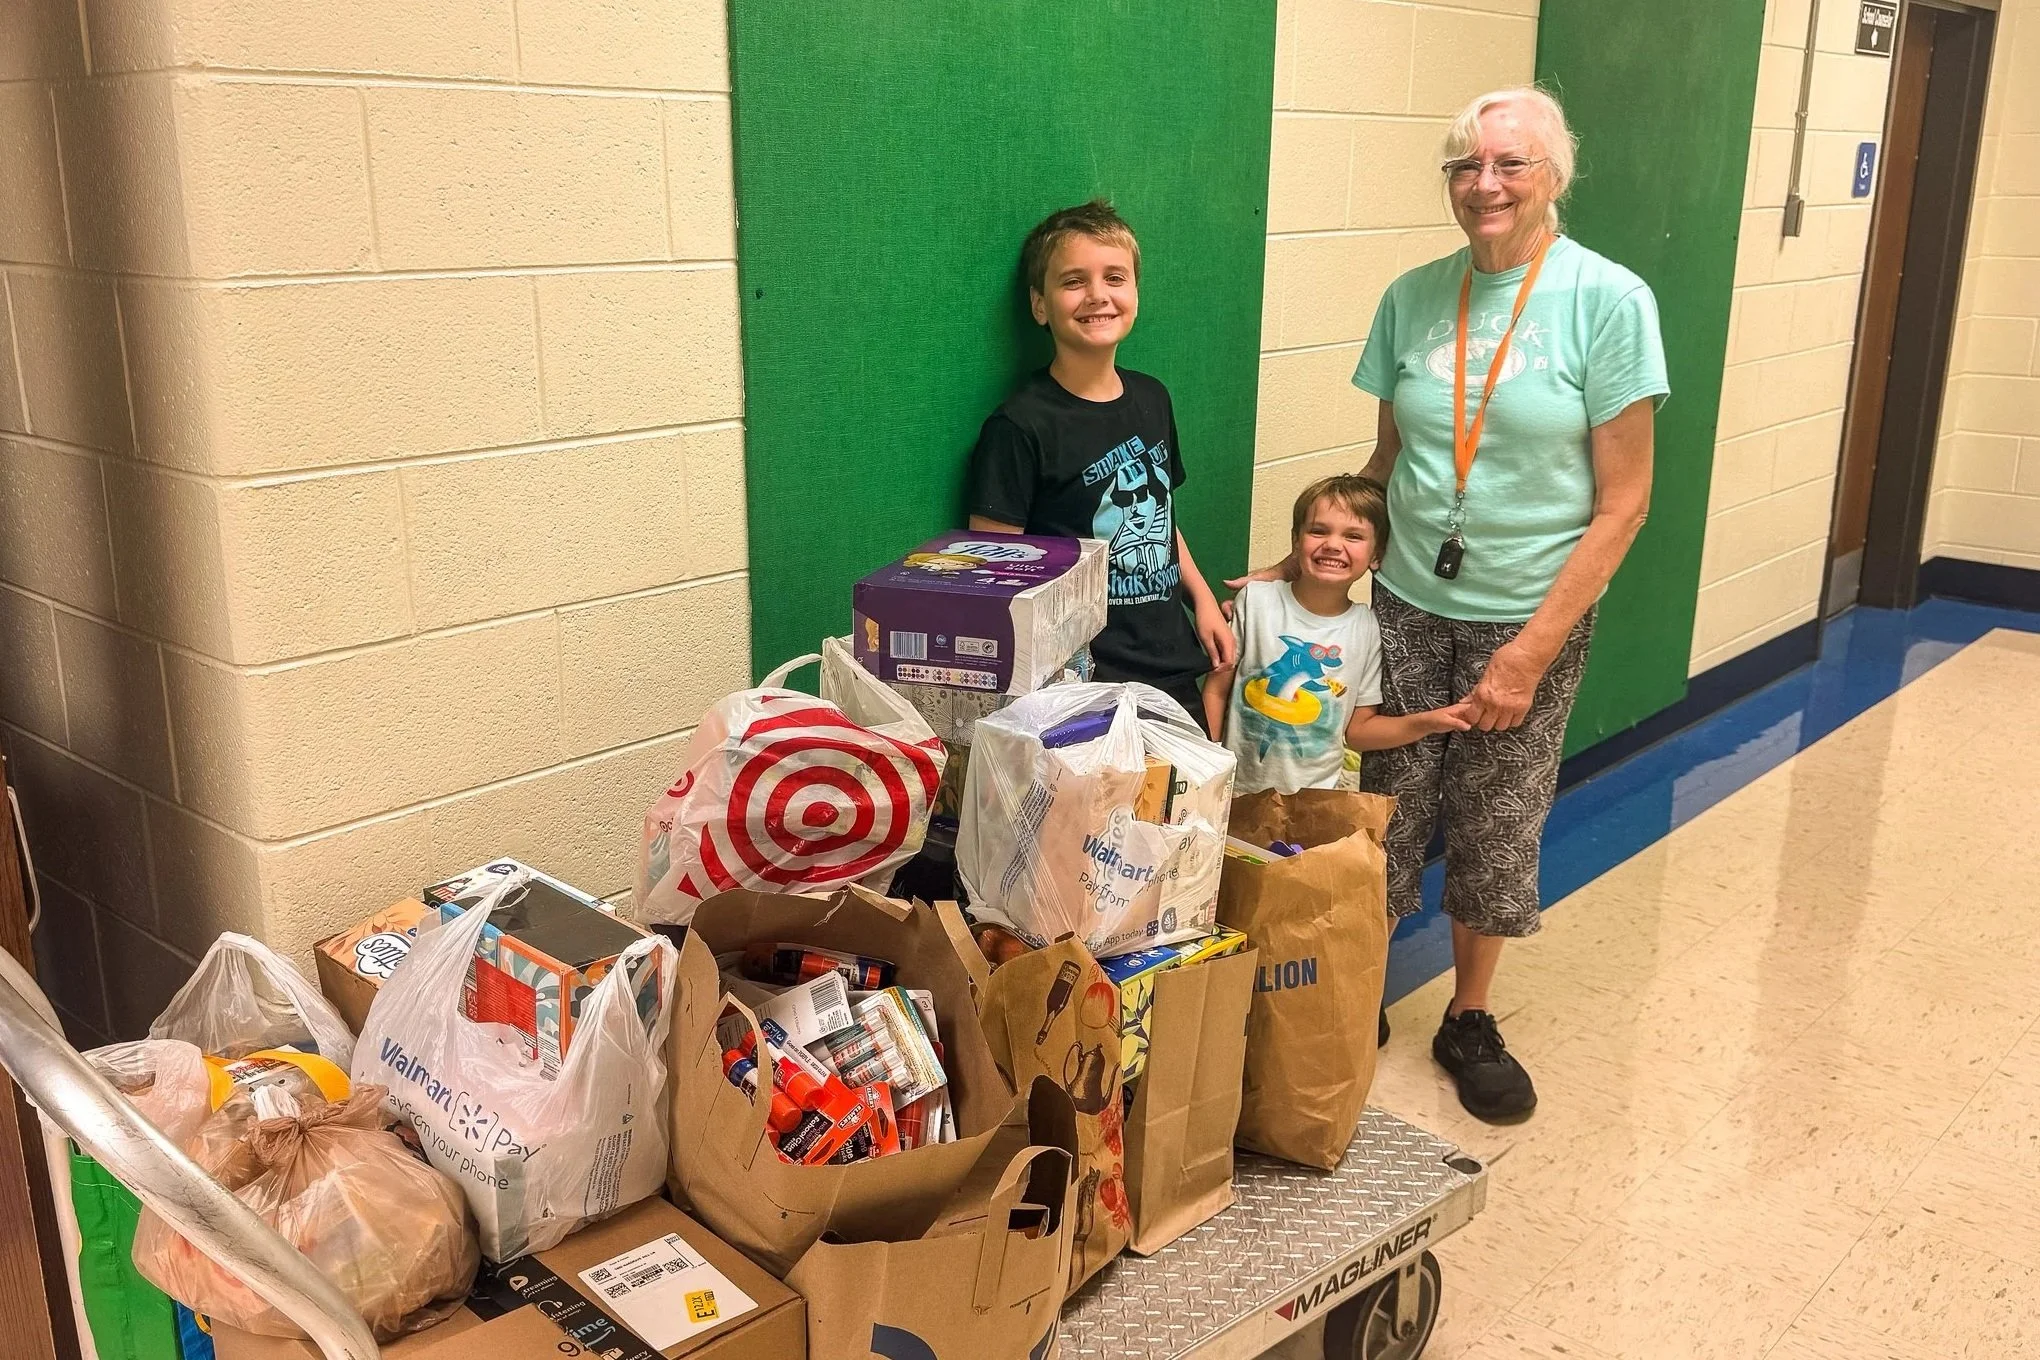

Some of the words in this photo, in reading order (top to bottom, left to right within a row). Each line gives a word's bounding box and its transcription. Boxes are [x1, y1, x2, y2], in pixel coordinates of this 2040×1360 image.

[1861, 6, 1876, 26] School
[1082, 436, 1146, 487] SHAKE
[1119, 459, 1145, 485] IT
[953, 543, 1027, 559] Puffs
[1108, 597, 1123, 606] OVER
[1082, 833, 1154, 882] Walmart
[1178, 833, 1198, 853] ay
[1104, 933, 1121, 947] App
[1258, 957, 1318, 992] LION
[379, 1036, 455, 1113] Walmart
[492, 1127, 541, 1163] Pay
[799, 1115, 821, 1140] School
[839, 1104, 864, 1129] ELMER'S
[432, 1131, 461, 1162] your
[459, 1157, 509, 1190] phone
[1293, 1216, 1432, 1321] MAGLINER
[551, 1300, 587, 1320] istening
[567, 1317, 609, 1339] ime
